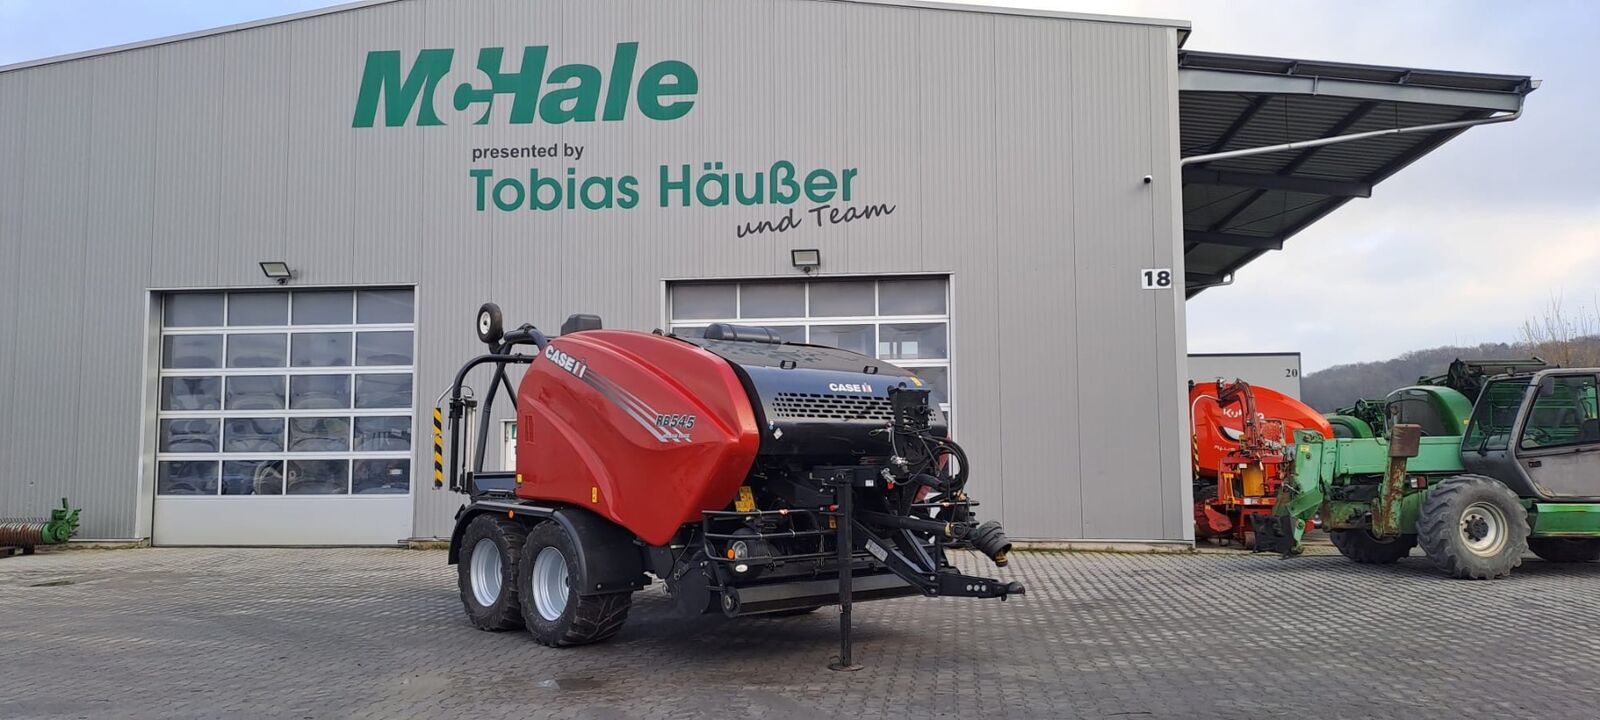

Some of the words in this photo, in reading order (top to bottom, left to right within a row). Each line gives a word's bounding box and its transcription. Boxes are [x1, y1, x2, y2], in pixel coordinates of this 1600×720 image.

[352, 41, 699, 128] McHale
[472, 143, 558, 162] presented
[563, 143, 584, 160] by
[469, 167, 640, 212] Tobias
[659, 160, 858, 207] Häußer
[736, 208, 802, 238] und
[808, 203, 896, 227] Team
[1144, 270, 1171, 287] 18
[545, 344, 576, 372] CASE
[1284, 368, 1298, 378] 20
[829, 383, 862, 392] CASE
[656, 414, 696, 429] RB545
